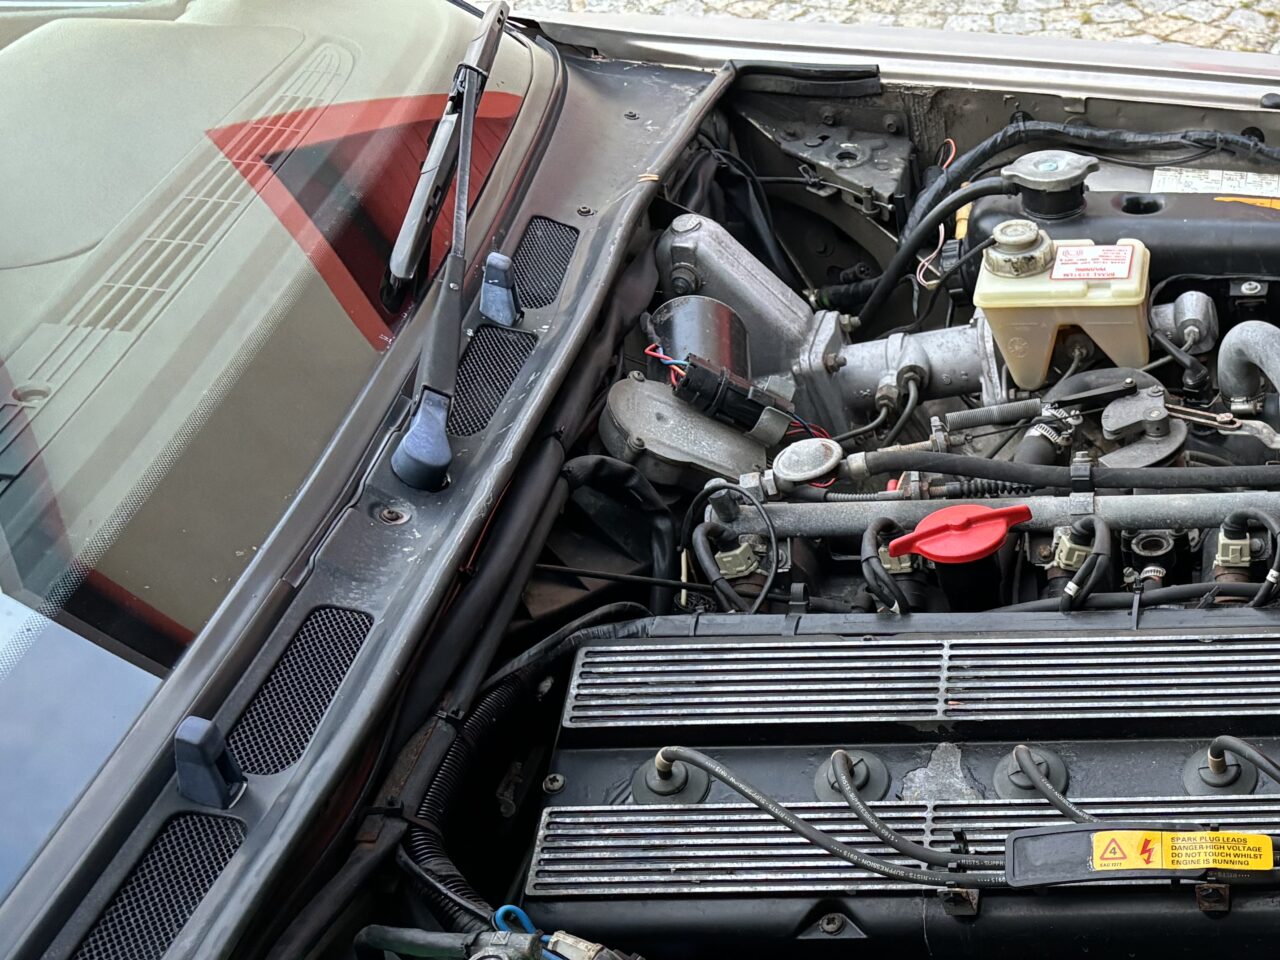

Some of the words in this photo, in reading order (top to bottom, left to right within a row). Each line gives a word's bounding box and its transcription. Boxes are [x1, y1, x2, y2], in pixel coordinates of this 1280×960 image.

[1109, 846, 1118, 856] 4
[1230, 852, 1263, 860] WHILST
[861, 858, 905, 877] SUPPRESSION
